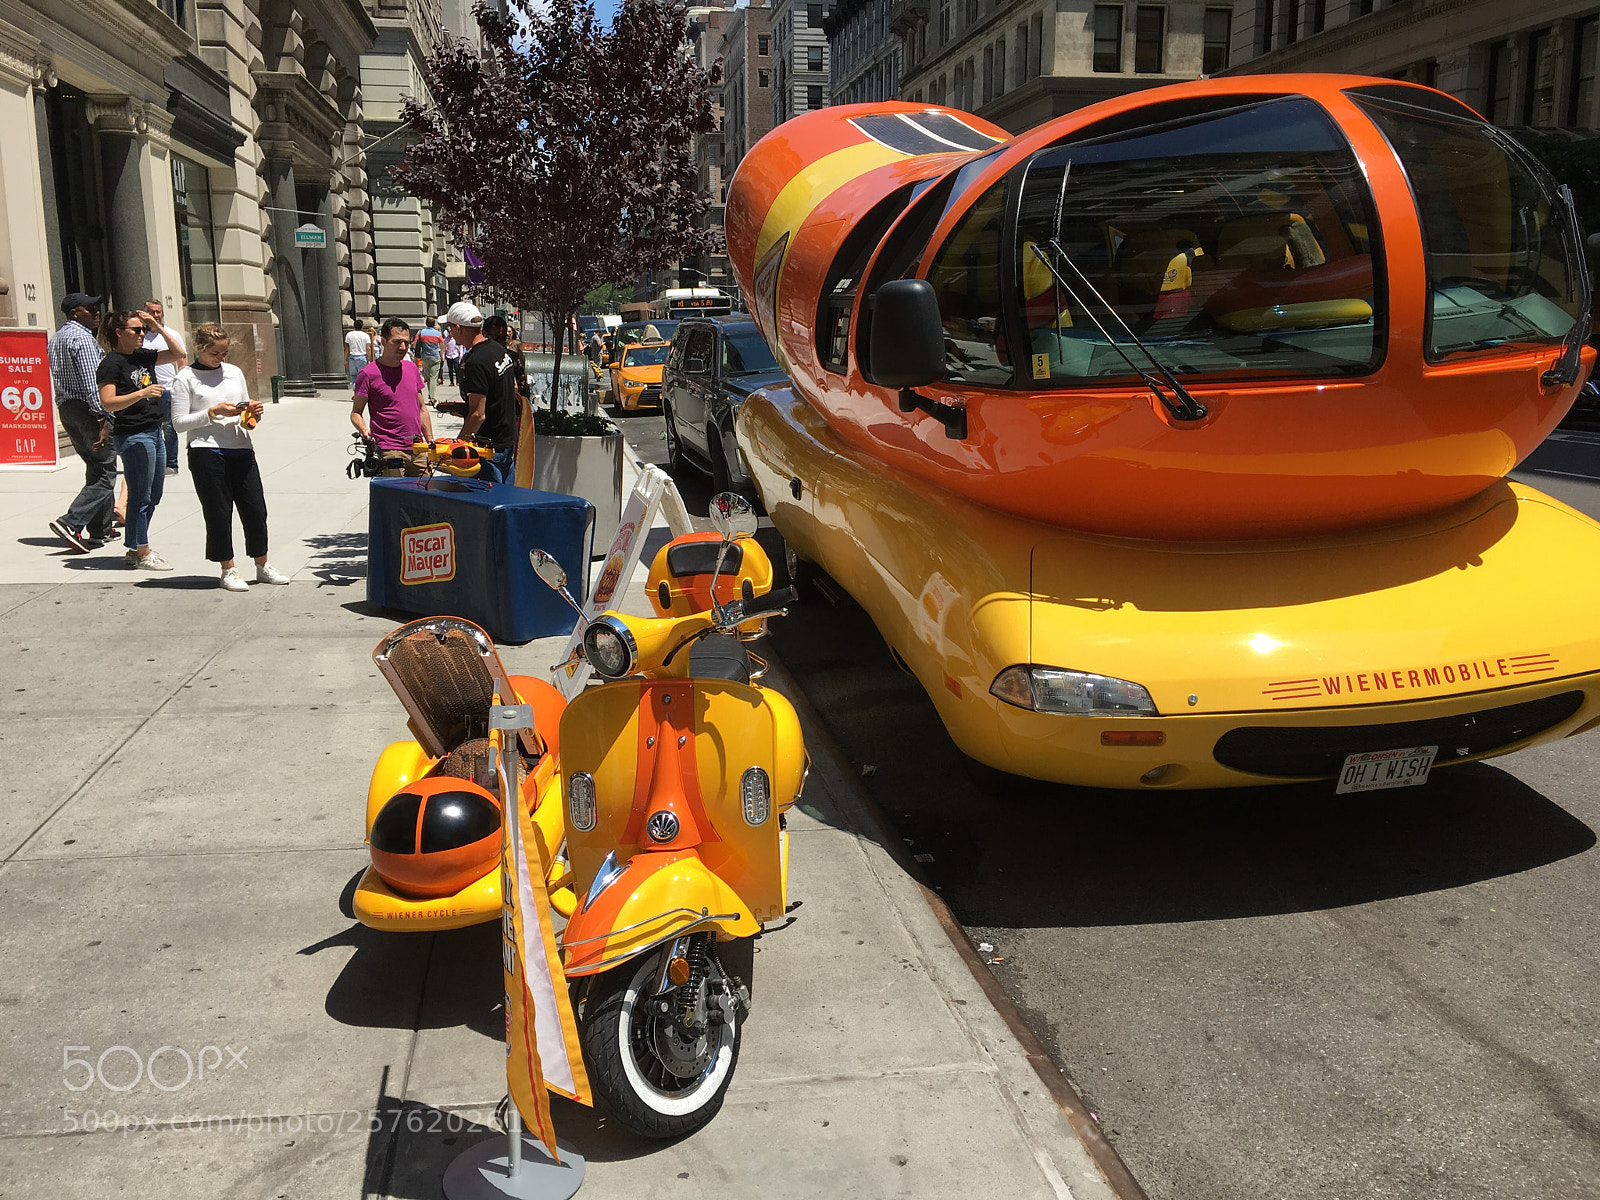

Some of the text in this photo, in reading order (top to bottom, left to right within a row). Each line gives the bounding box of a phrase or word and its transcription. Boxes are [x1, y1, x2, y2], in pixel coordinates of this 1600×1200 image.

[23, 283, 36, 301] 122
[0, 356, 42, 365] SUMMER
[1037, 355, 1044, 367] 5
[8, 365, 33, 373] SALE
[15, 438, 36, 453] GAP
[408, 536, 447, 554] Oscar
[407, 553, 449, 579] Mayer
[1322, 658, 1510, 696] WIENERMOBILE
[1349, 751, 1398, 763] WICONSIN
[1343, 756, 1431, 785] OH I WISH
[386, 908, 457, 920] WIENER CYCLE
